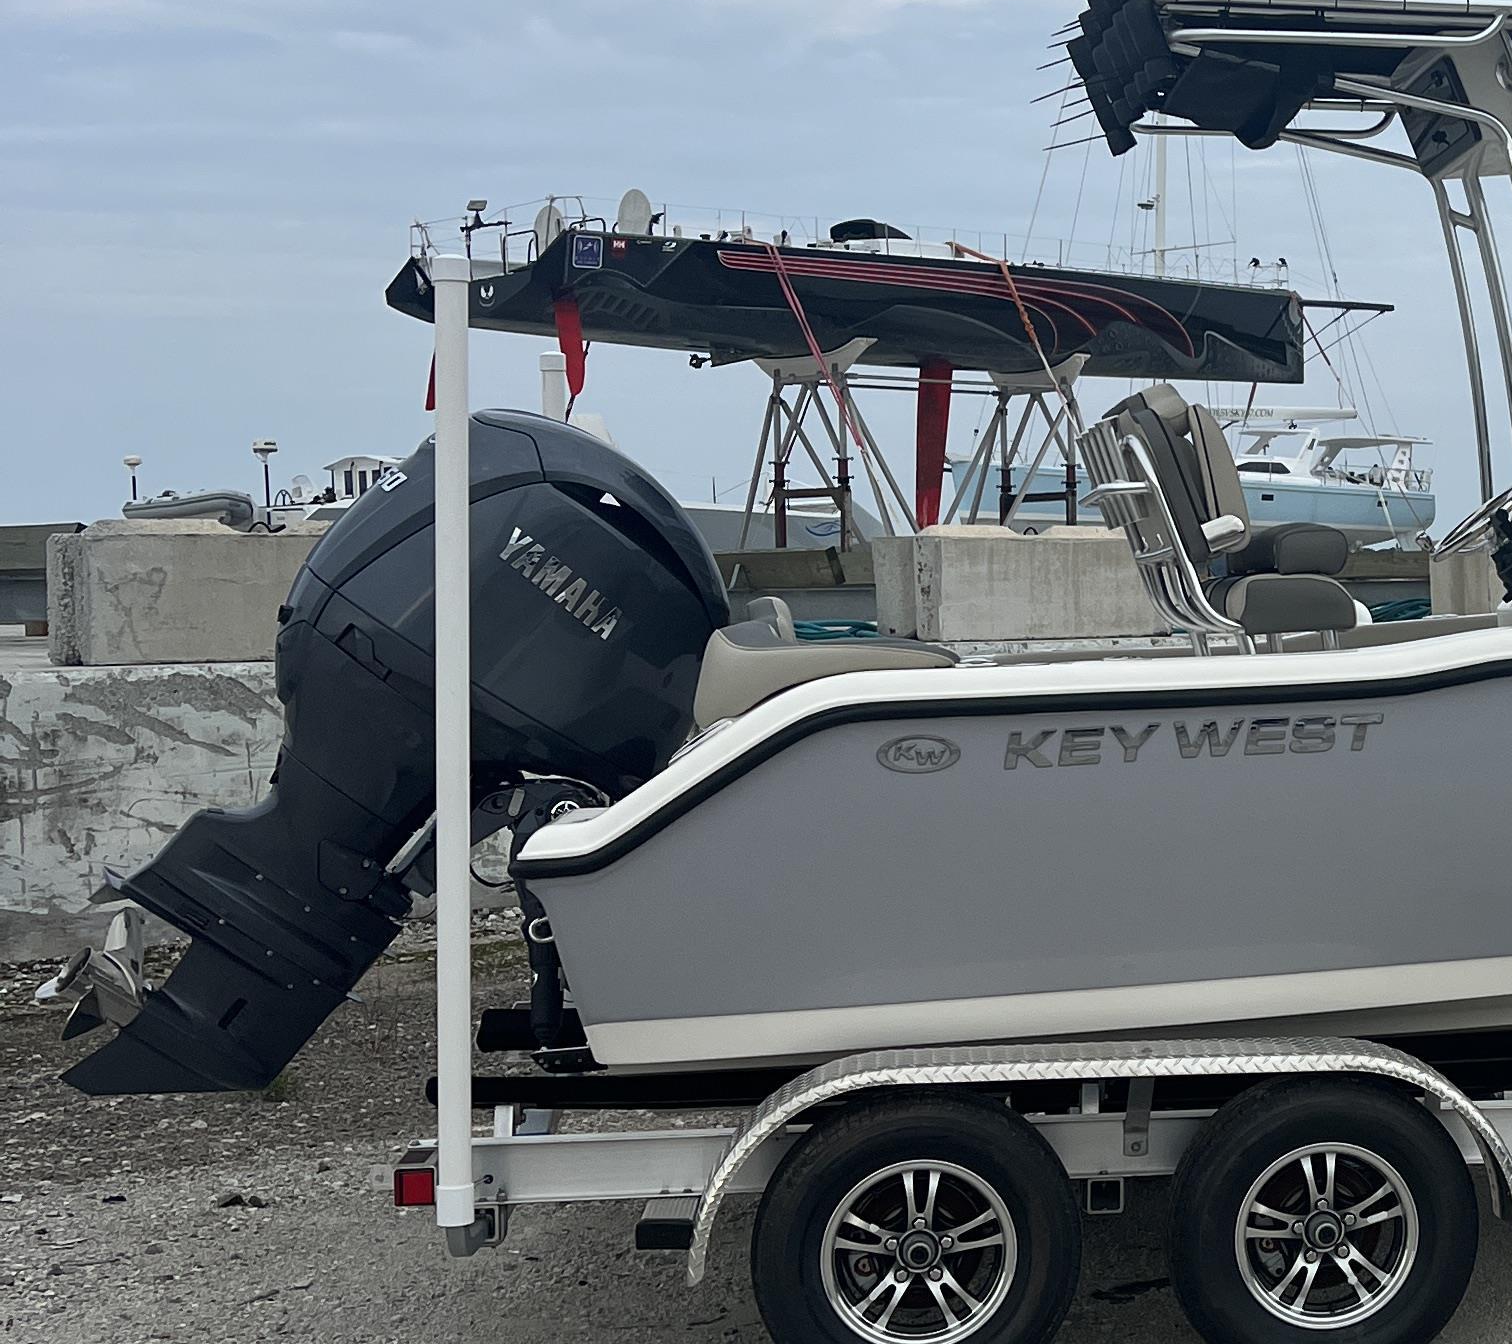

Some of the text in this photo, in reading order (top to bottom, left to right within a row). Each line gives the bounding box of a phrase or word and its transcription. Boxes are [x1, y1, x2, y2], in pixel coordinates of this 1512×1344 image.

[499, 527, 623, 641] YAMAHA
[1003, 712, 1385, 770] KEY WEST
